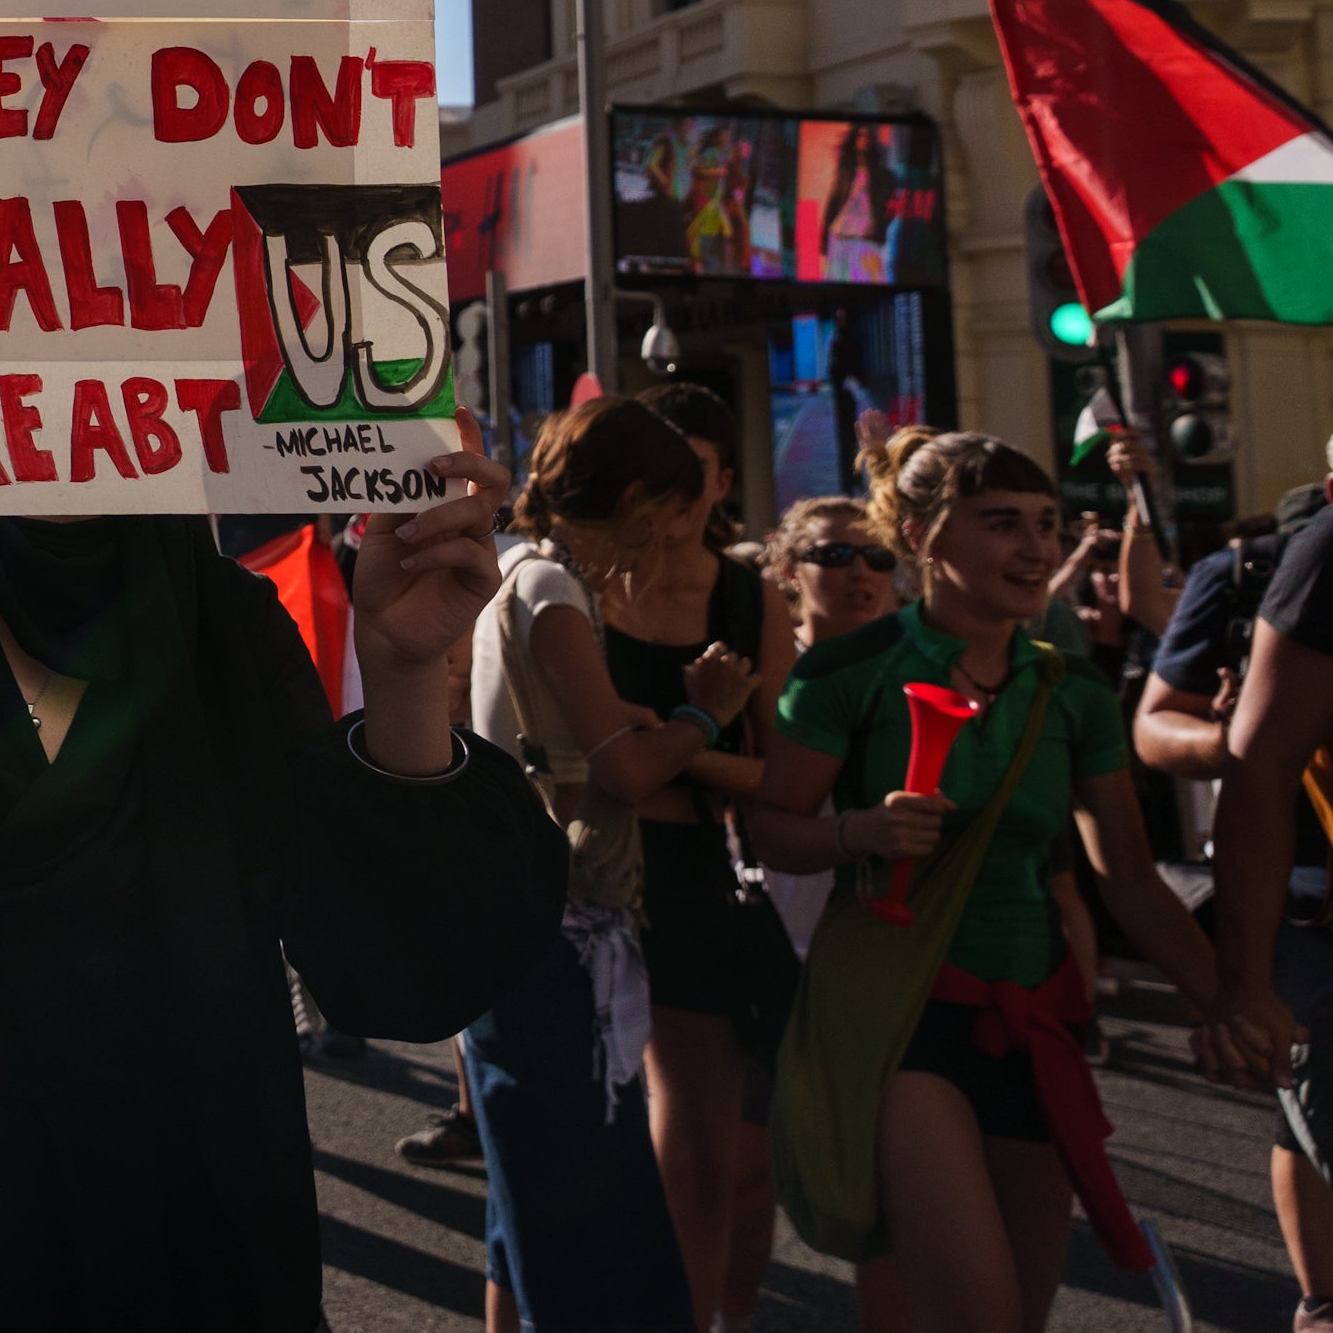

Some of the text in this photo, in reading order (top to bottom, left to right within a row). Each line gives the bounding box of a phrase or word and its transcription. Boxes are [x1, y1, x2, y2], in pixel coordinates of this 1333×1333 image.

[151, 45, 437, 149] DON'T
[261, 220, 452, 414] US
[70, 374, 242, 484] ABT
[301, 465, 447, 505] JACKSON
